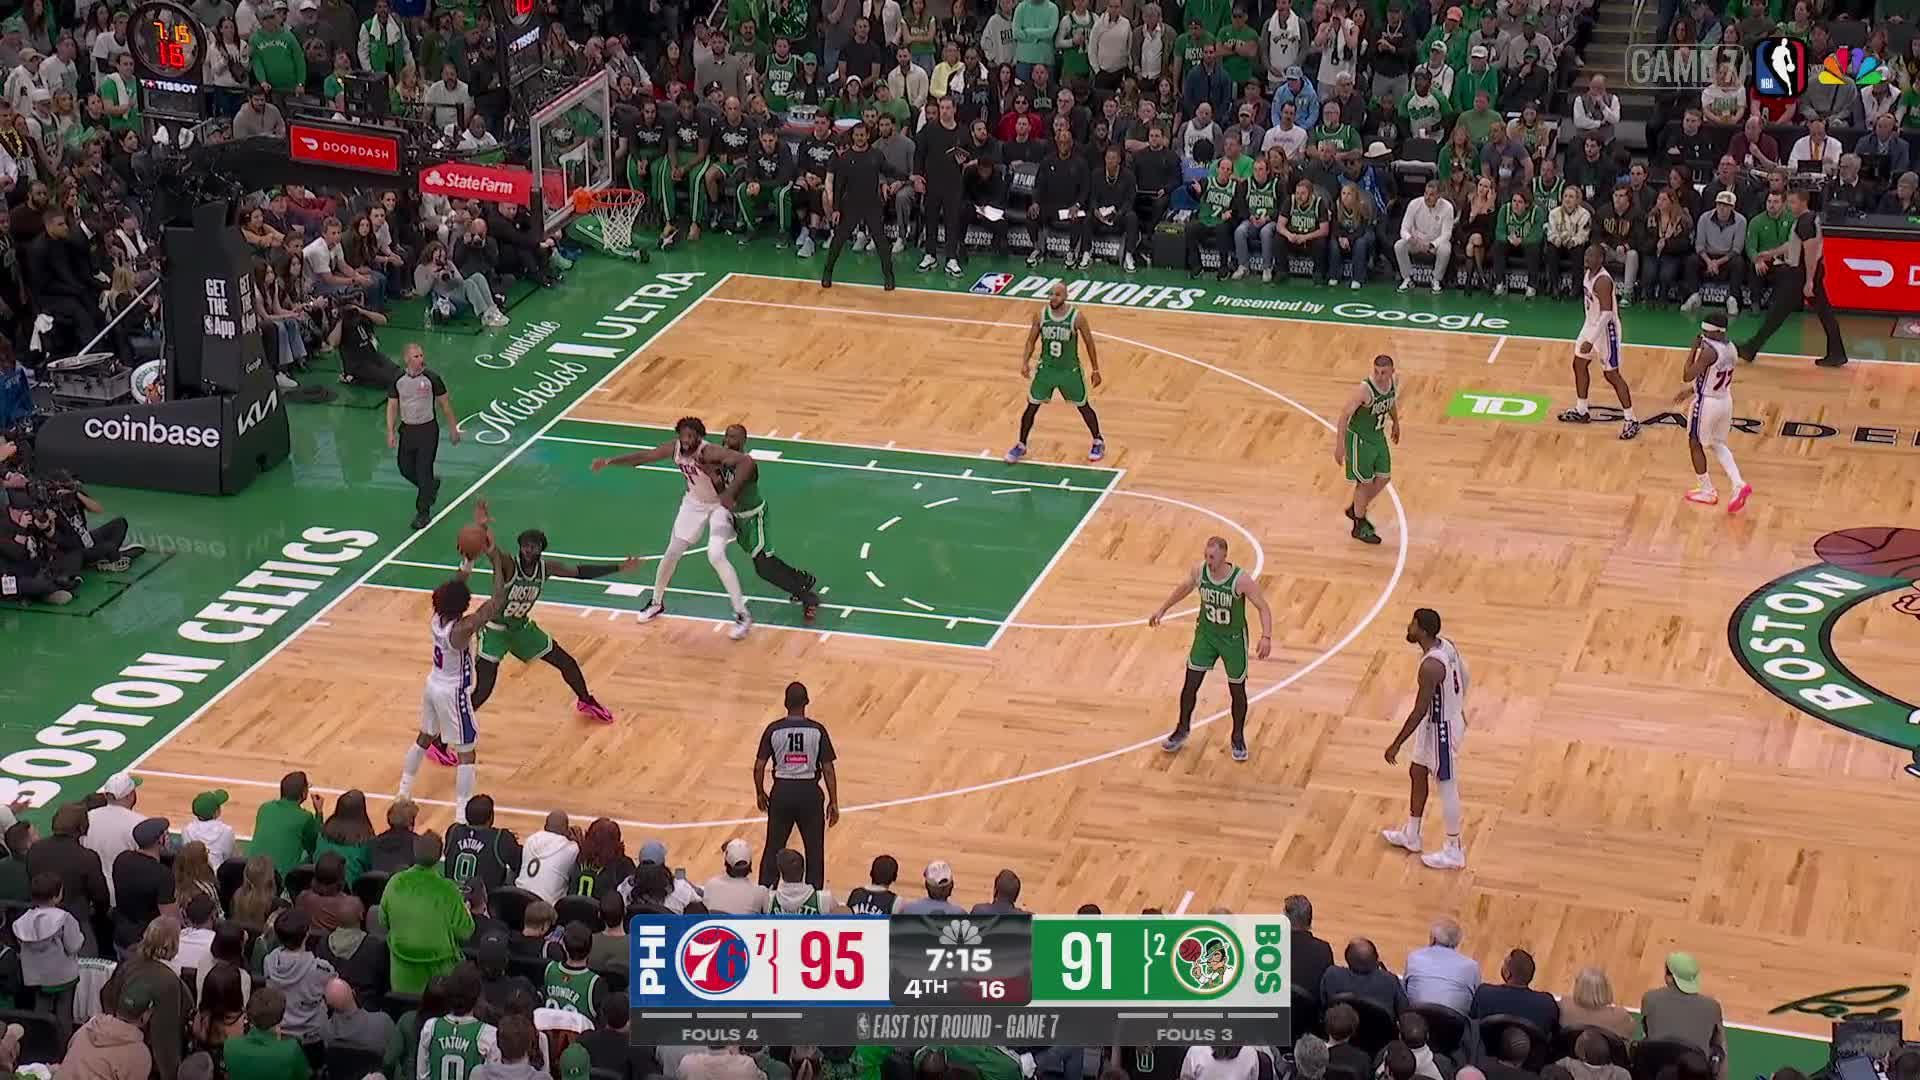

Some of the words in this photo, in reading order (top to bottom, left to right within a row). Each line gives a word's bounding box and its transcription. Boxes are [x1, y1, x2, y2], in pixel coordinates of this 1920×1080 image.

[769, 69, 794, 82] BOSTON
[158, 81, 198, 95] TISSOT
[771, 81, 789, 96] 42
[322, 142, 389, 160] DOORDASH
[1211, 205, 1222, 218] 7
[205, 278, 227, 298] GET
[1006, 275, 1207, 309] PLAYOFFS
[207, 297, 230, 316] THE
[582, 271, 707, 339] ULTRA
[1213, 295, 1302, 312] Presented
[1302, 301, 1325, 315] by
[1332, 303, 1511, 329] Google
[215, 317, 236, 340] App
[1042, 326, 1072, 341] BOSTON
[475, 319, 560, 369] Courtside
[1713, 369, 1734, 391] 77
[475, 358, 588, 445] Michelob
[1462, 394, 1538, 416] TD
[84, 414, 220, 448] coinbase
[1580, 406, 1920, 447] GARDE
[178, 526, 379, 643] CELTICS
[1200, 587, 1233, 607] BOSTON
[1205, 604, 1231, 625] 30
[1749, 572, 1875, 711] BOSTON
[0, 652, 226, 808] BOSTON
[787, 733, 804, 752] 19
[457, 837, 485, 853] TATUM
[454, 852, 478, 881] 0
[578, 874, 595, 898] 0
[547, 984, 581, 1003] CROWDER
[438, 1035, 470, 1052] TATUM
[441, 1054, 466, 1080] 0
